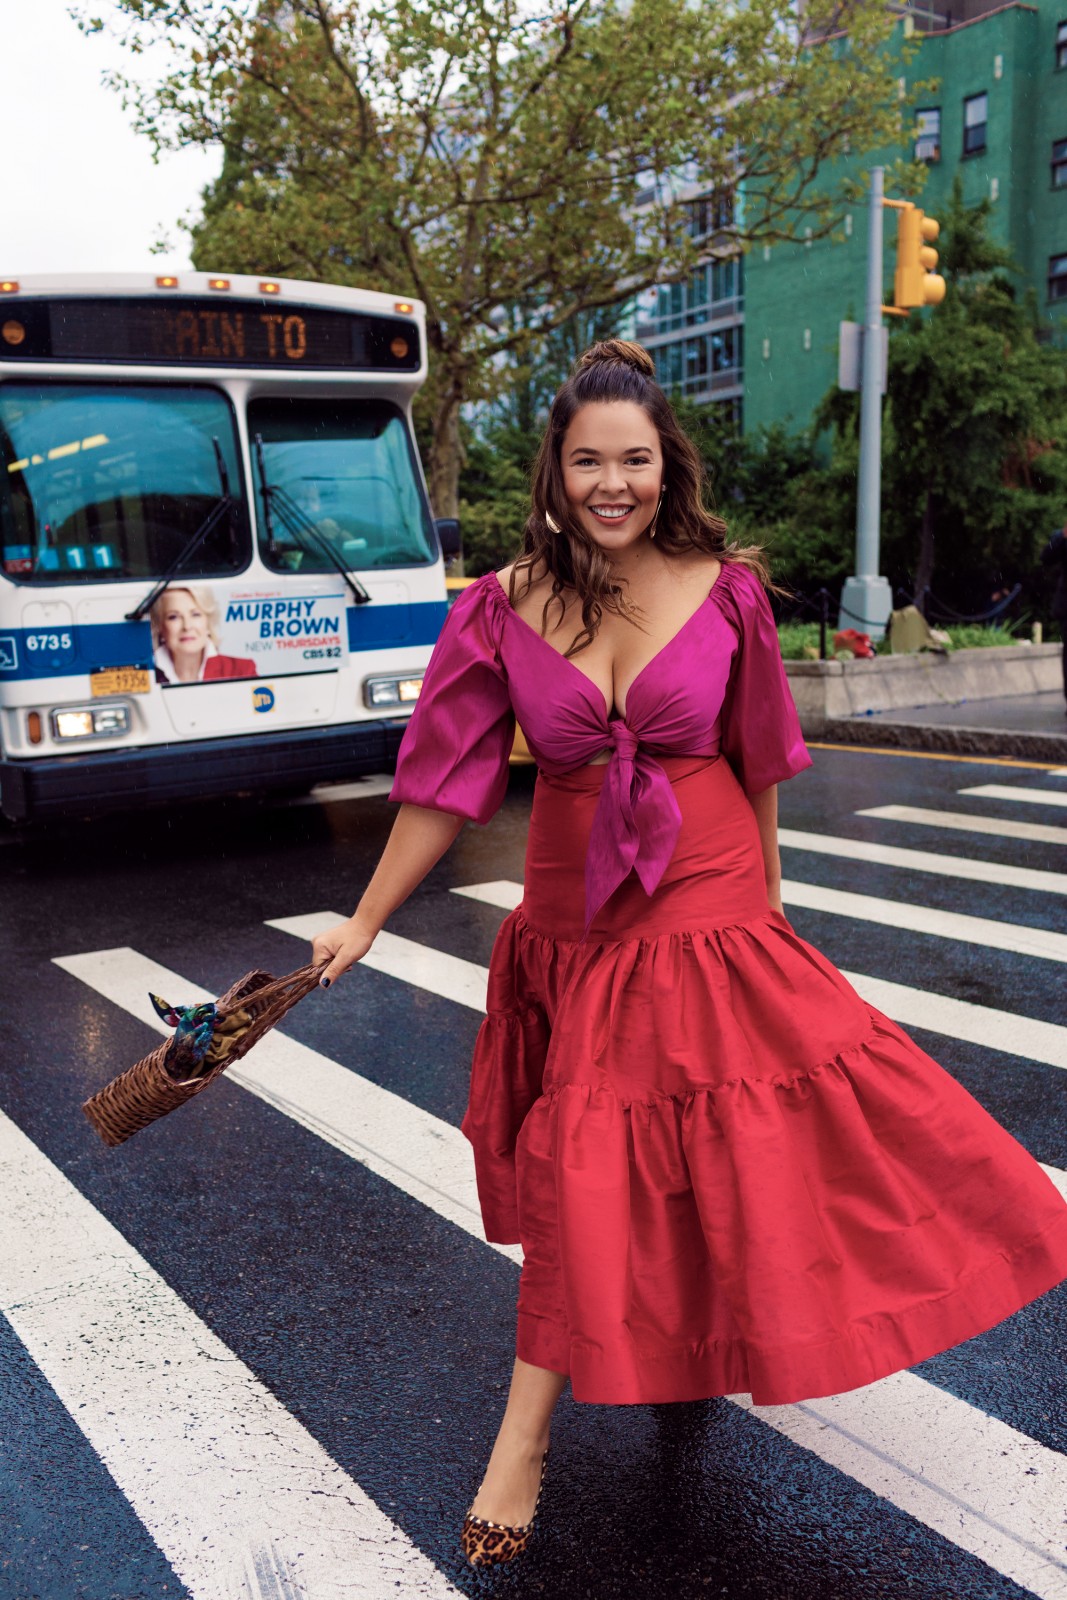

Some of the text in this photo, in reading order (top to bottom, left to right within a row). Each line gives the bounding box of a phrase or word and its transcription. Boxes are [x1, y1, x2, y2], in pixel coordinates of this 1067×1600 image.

[260, 313, 307, 360] TO
[226, 600, 315, 622] MURPHY
[259, 617, 339, 638] BROWN
[26, 633, 72, 651] 6735
[245, 636, 340, 652] NEW THURSDAYS
